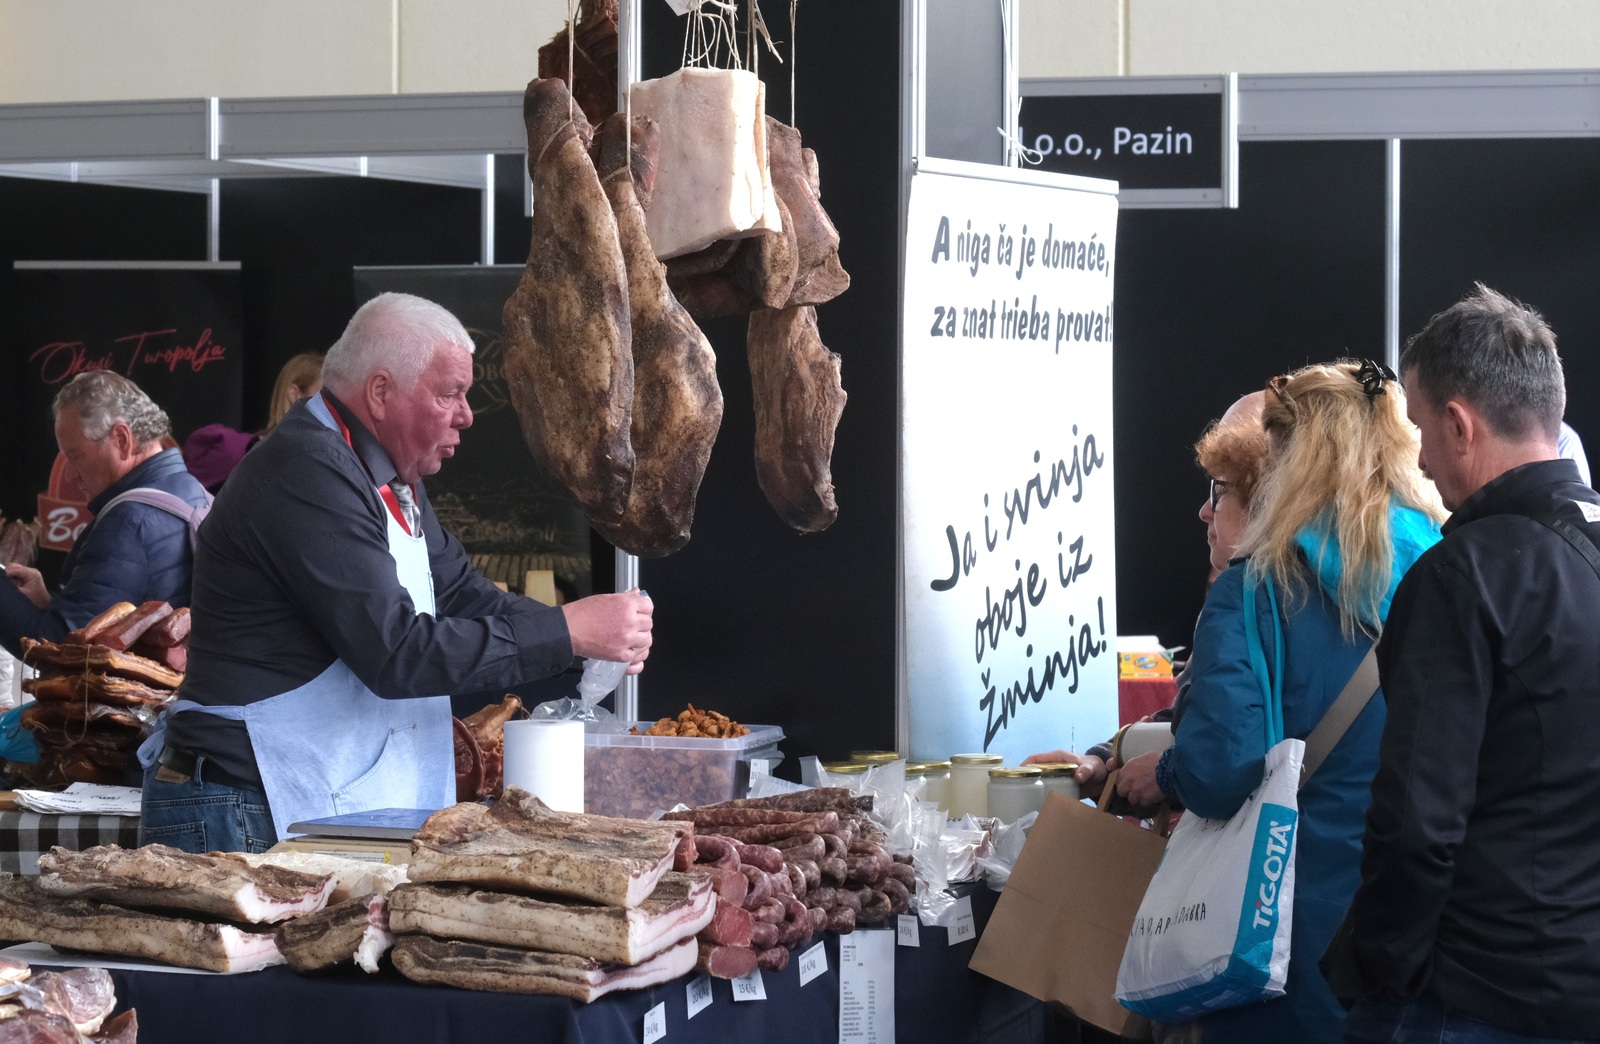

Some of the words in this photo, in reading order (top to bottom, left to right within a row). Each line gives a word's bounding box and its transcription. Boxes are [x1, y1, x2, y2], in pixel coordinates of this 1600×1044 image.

[1018, 126, 1102, 160] .o.o.,
[1113, 126, 1193, 155] Pazin
[931, 215, 950, 264] A
[956, 219, 991, 278] niga
[997, 223, 1014, 267] ča
[1015, 224, 1036, 281] je
[1042, 223, 1110, 278] domaće,
[930, 305, 957, 339] za
[962, 299, 997, 339] znat
[1001, 294, 1050, 341] trieba
[114, 328, 227, 376] Turopolja
[930, 524, 977, 592] Ja
[984, 493, 998, 552] i
[1004, 424, 1104, 541] svinja
[975, 558, 1047, 664] oboje
[1057, 531, 1093, 589] iz
[979, 596, 1107, 753] Žminja!
